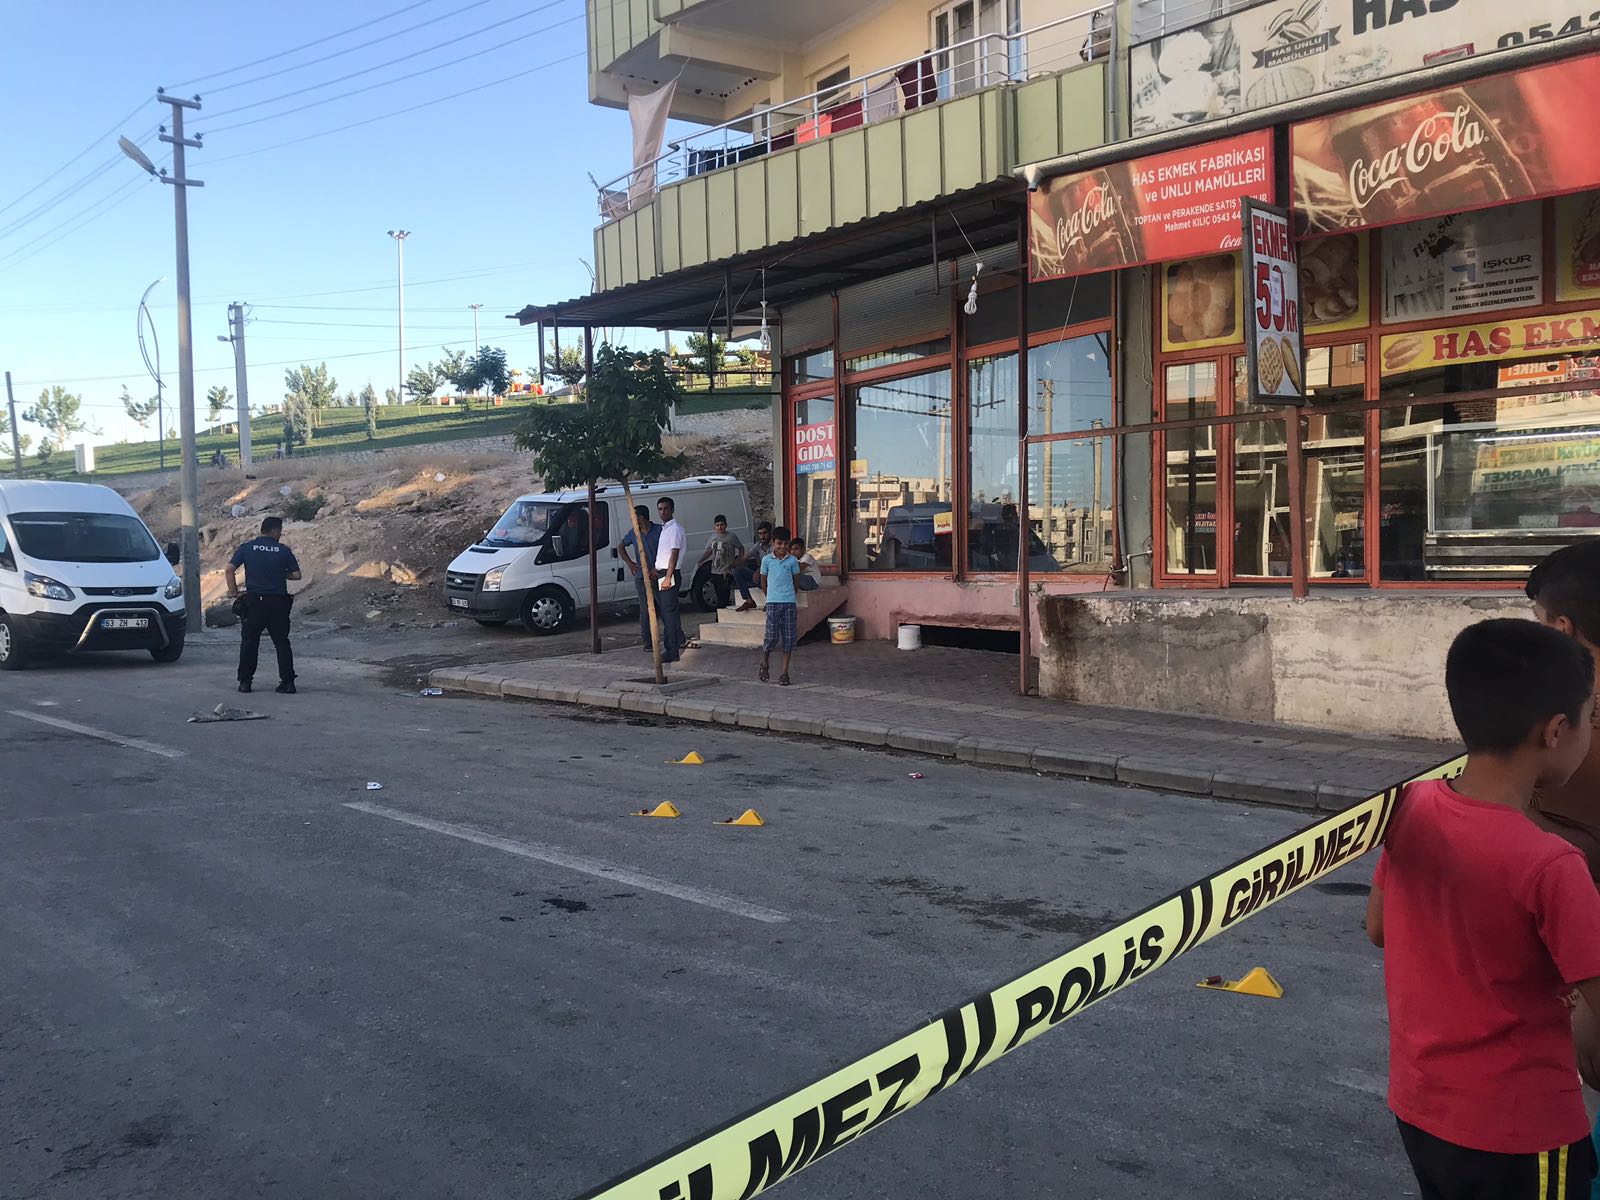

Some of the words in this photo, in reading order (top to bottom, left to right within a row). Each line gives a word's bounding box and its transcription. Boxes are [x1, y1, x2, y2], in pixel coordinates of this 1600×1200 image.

[1353, 0, 1459, 35] HA
[1272, 46, 1292, 58] HAS
[1294, 37, 1322, 50] UNLU
[1132, 170, 1154, 186] HAS
[1158, 161, 1198, 182] EKMEK
[1200, 146, 1265, 172] FABRİKASI
[1350, 104, 1485, 208] Coca-Cola
[1145, 190, 1158, 203] ve
[1160, 182, 1192, 200] UNLU
[1195, 164, 1265, 194] MAMÜLLERİ
[1056, 182, 1117, 260] Coca-Cola
[1134, 212, 1161, 226] TOPTAN
[1163, 212, 1171, 220] ve
[1172, 203, 1214, 219] PERAKENDE
[1216, 198, 1236, 212] SATIŞ
[1165, 219, 1191, 232] Mehmet
[1192, 216, 1211, 227] KILIÇ
[1212, 212, 1230, 224] 0543
[1286, 299, 1298, 332] KR
[1432, 326, 1512, 360] HAS
[796, 424, 835, 444] DOST
[798, 444, 834, 462] GIDA
